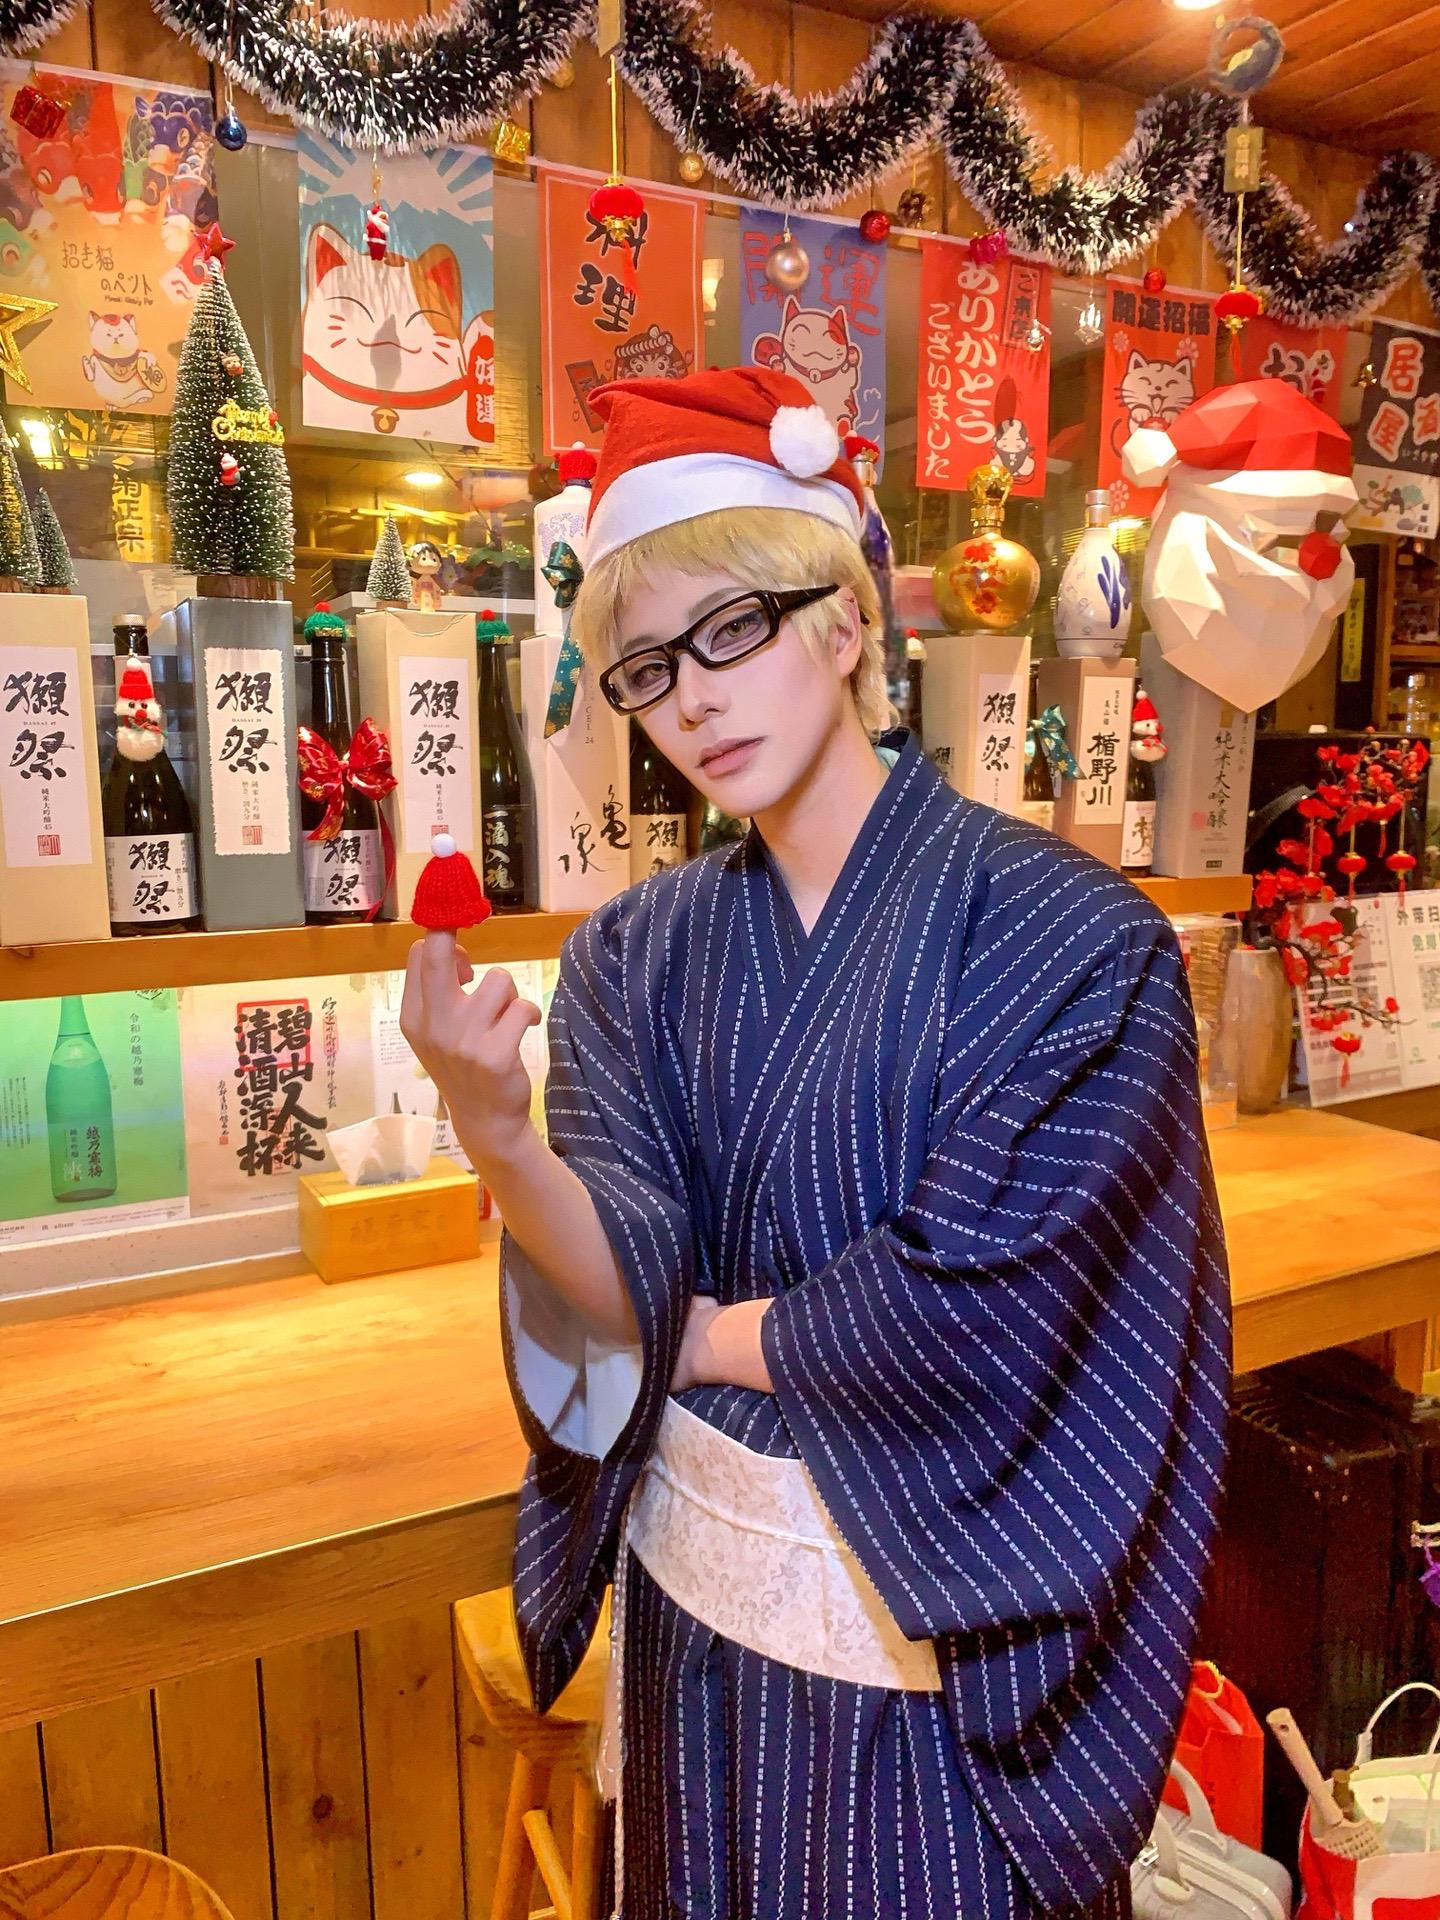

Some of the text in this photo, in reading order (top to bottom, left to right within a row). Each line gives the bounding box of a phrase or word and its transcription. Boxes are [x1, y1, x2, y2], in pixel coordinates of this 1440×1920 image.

[62, 240, 114, 271] 招き猫
[100, 272, 153, 296] のペット
[924, 302, 953, 479] ございました
[954, 258, 999, 445] ありがとう
[3, 671, 76, 781] 獺祭
[215, 671, 278, 775] 獺祭
[408, 679, 464, 777] 獺祭
[981, 692, 1016, 772] 獺祭
[1086, 731, 1120, 806] 楯野川
[1206, 730, 1235, 829] 純米大吟醸
[128, 840, 176, 914] 獺祭
[323, 836, 364, 906] 獺祭
